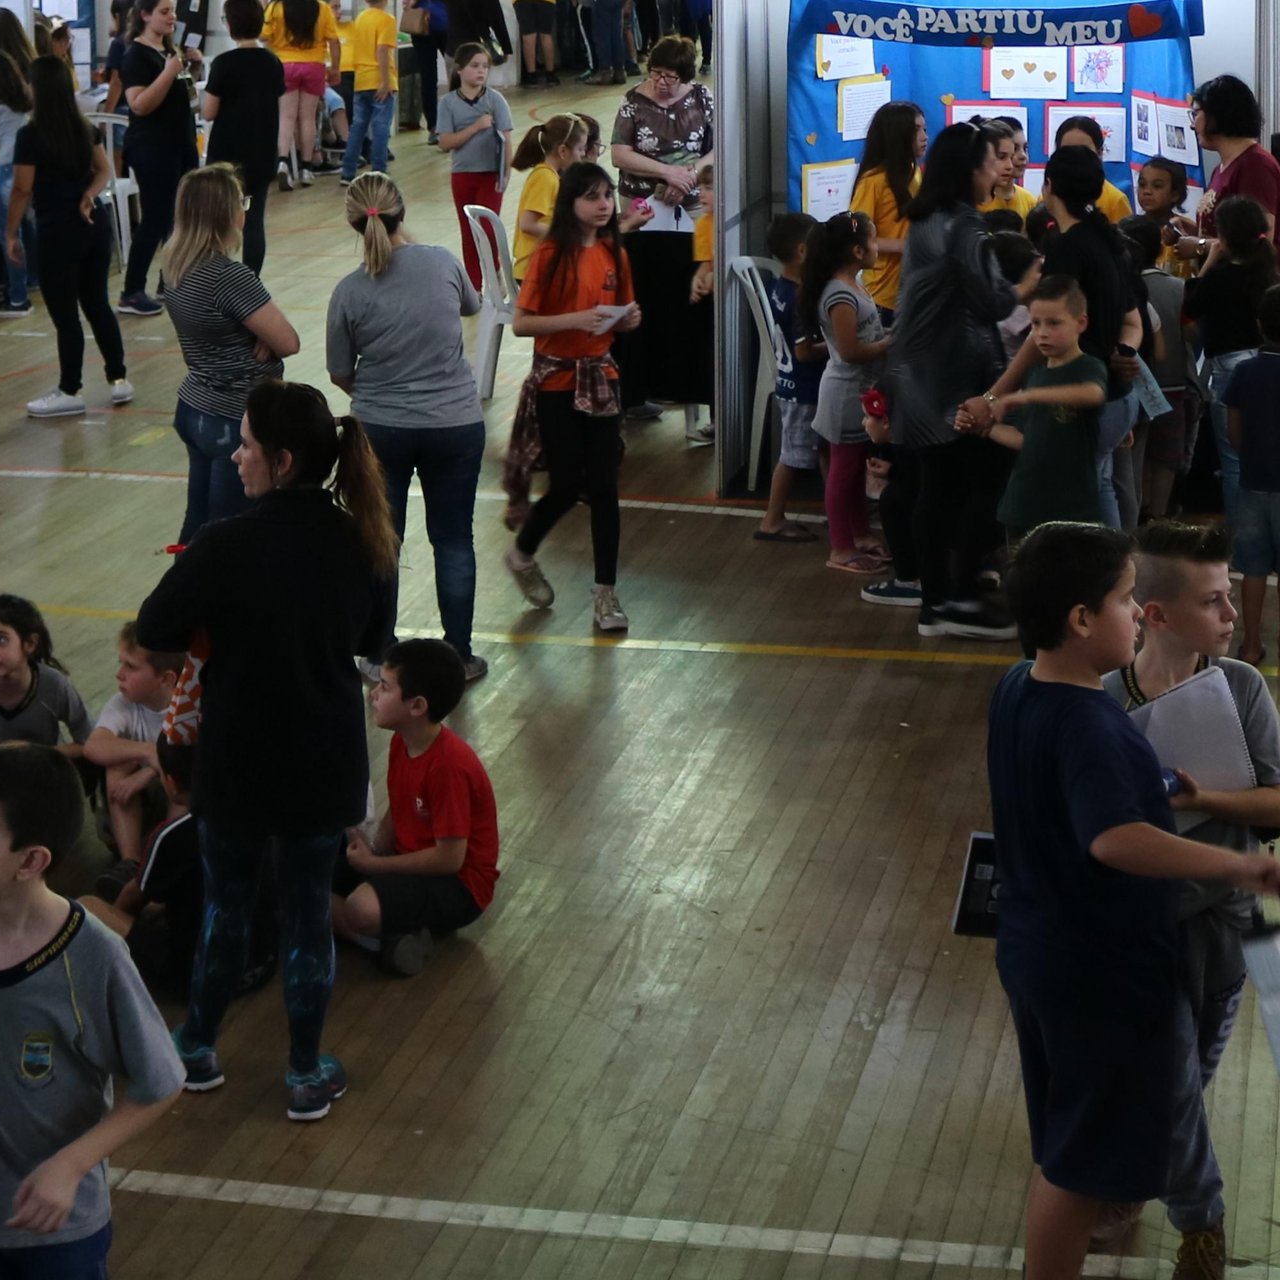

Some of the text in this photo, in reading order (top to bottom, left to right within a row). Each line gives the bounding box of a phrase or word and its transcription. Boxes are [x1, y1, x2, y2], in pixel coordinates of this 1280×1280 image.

[832, 7, 1122, 47] VOCÊ PARTIU MEU
